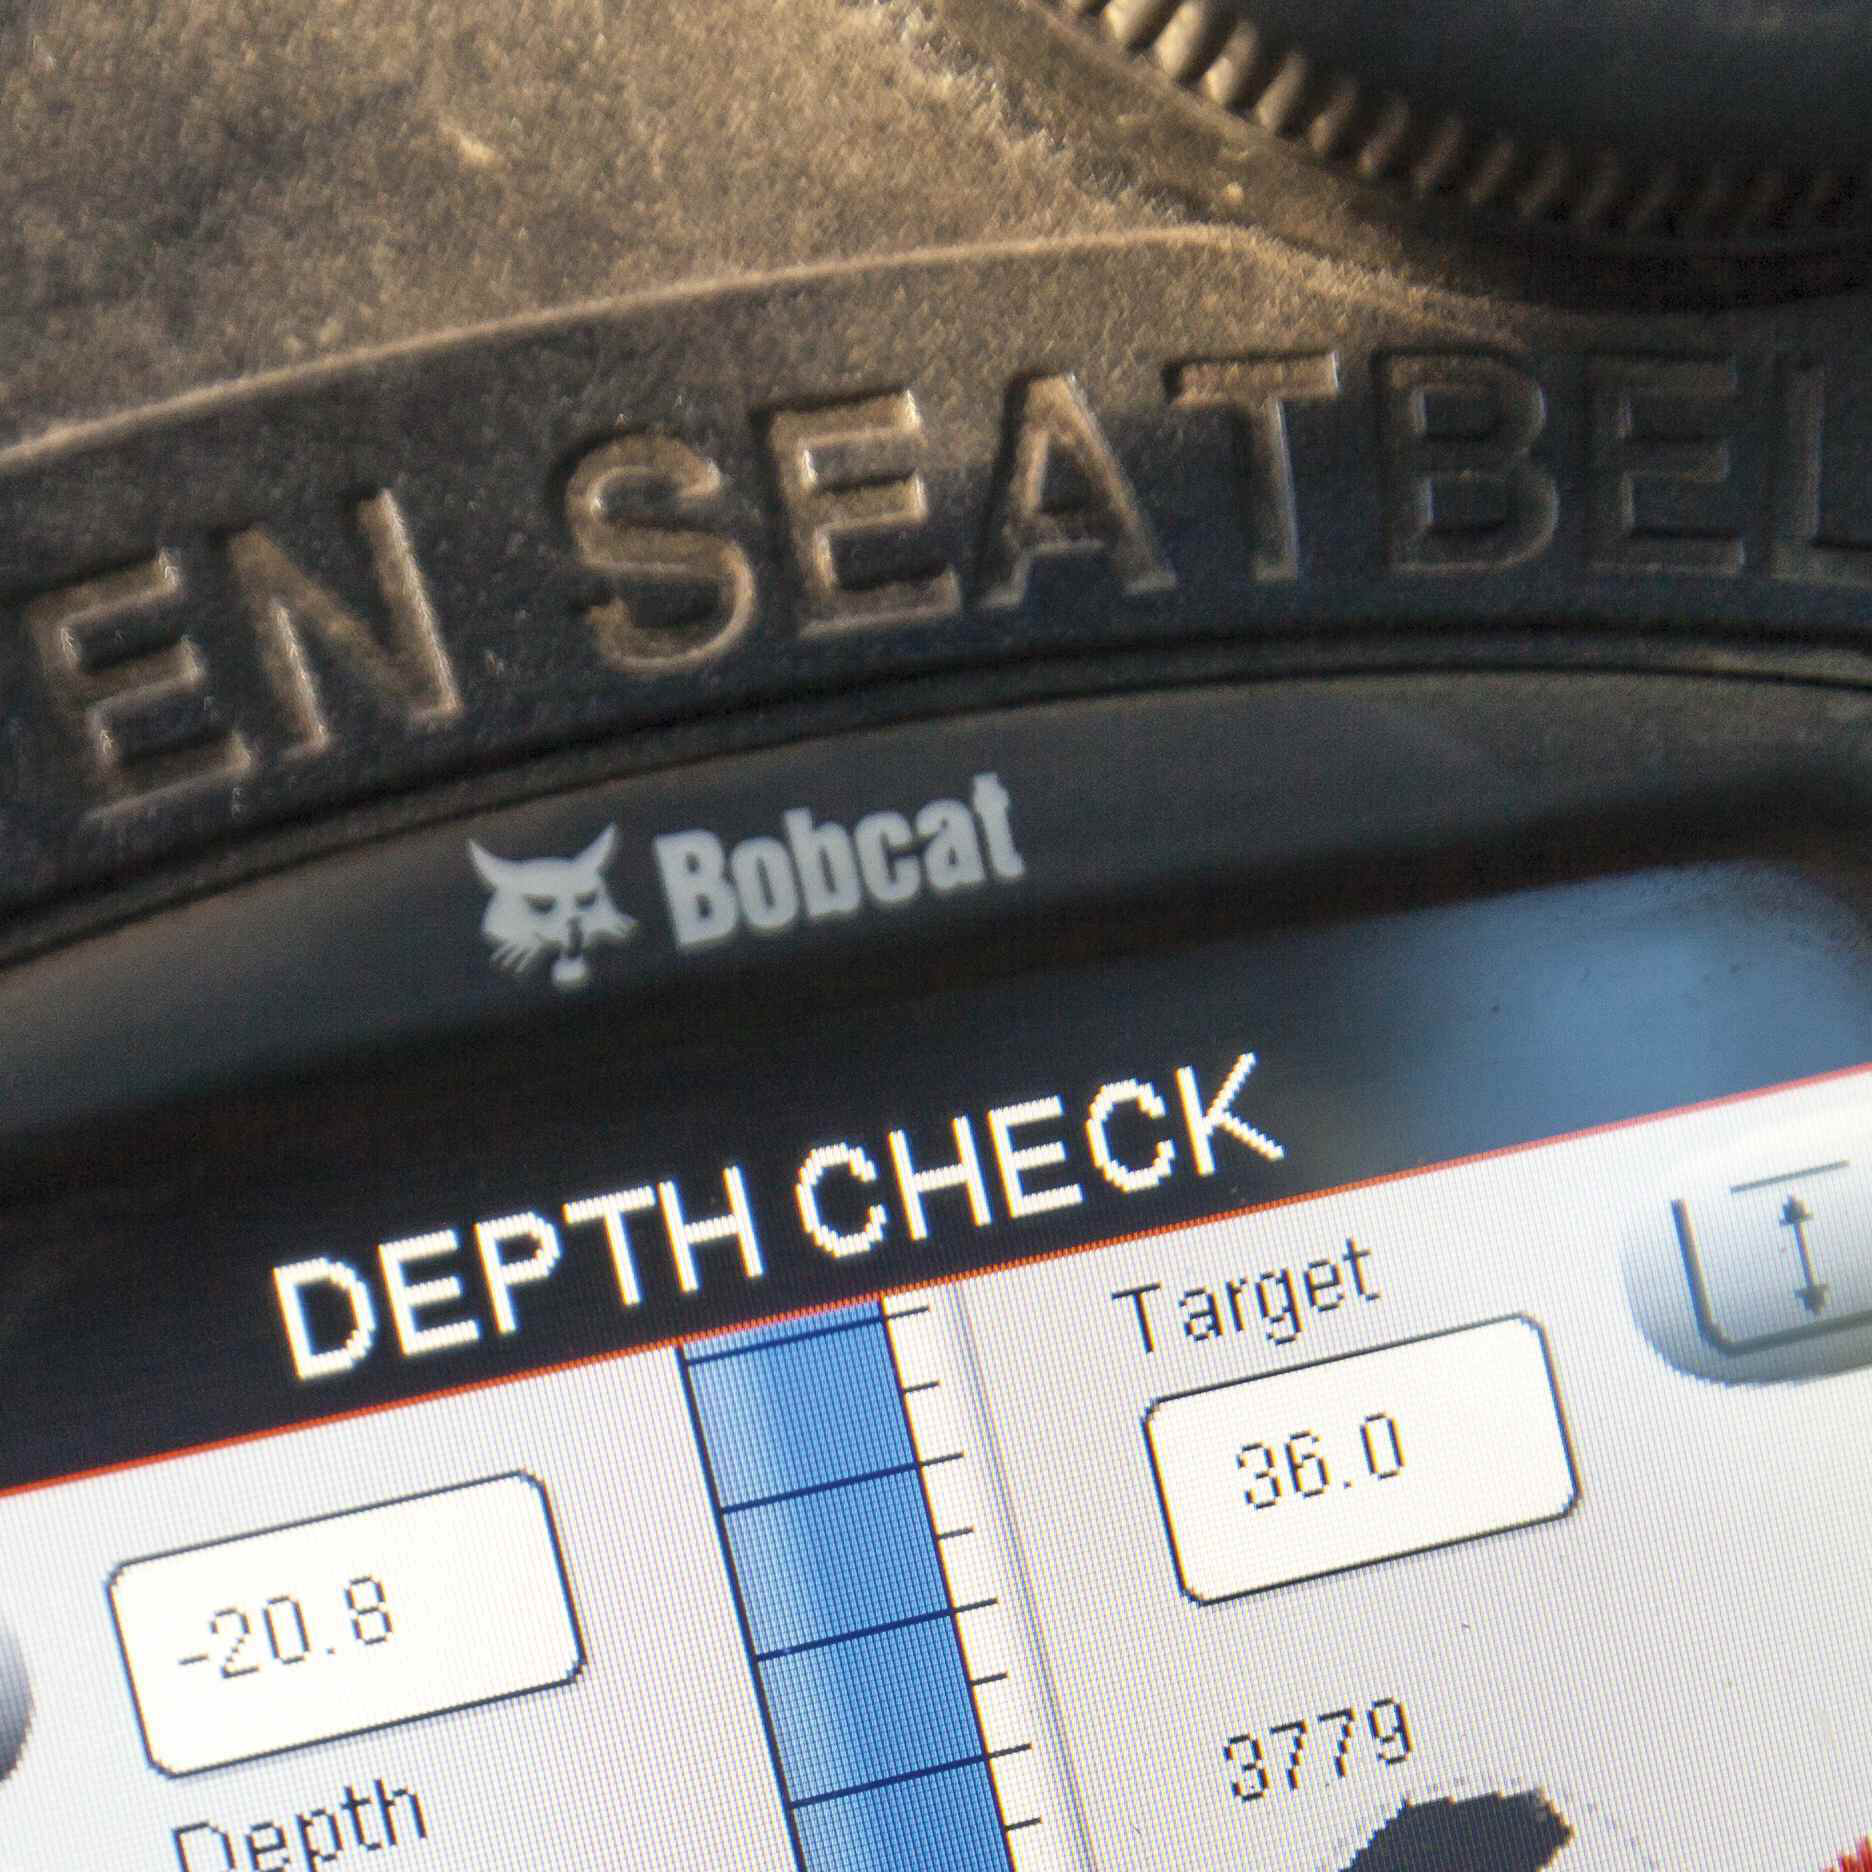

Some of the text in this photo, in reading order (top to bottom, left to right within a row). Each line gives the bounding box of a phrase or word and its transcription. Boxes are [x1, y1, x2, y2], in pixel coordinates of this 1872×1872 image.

[657, 772, 1024, 958] Bobcat
[270, 1050, 1283, 1390] DEPTH CHECK
[1112, 1236, 1379, 1362] Target
[1232, 1408, 1408, 1514] 36.0
[177, 1576, 396, 1689] -20.8
[1221, 1698, 1413, 1804] 3779
